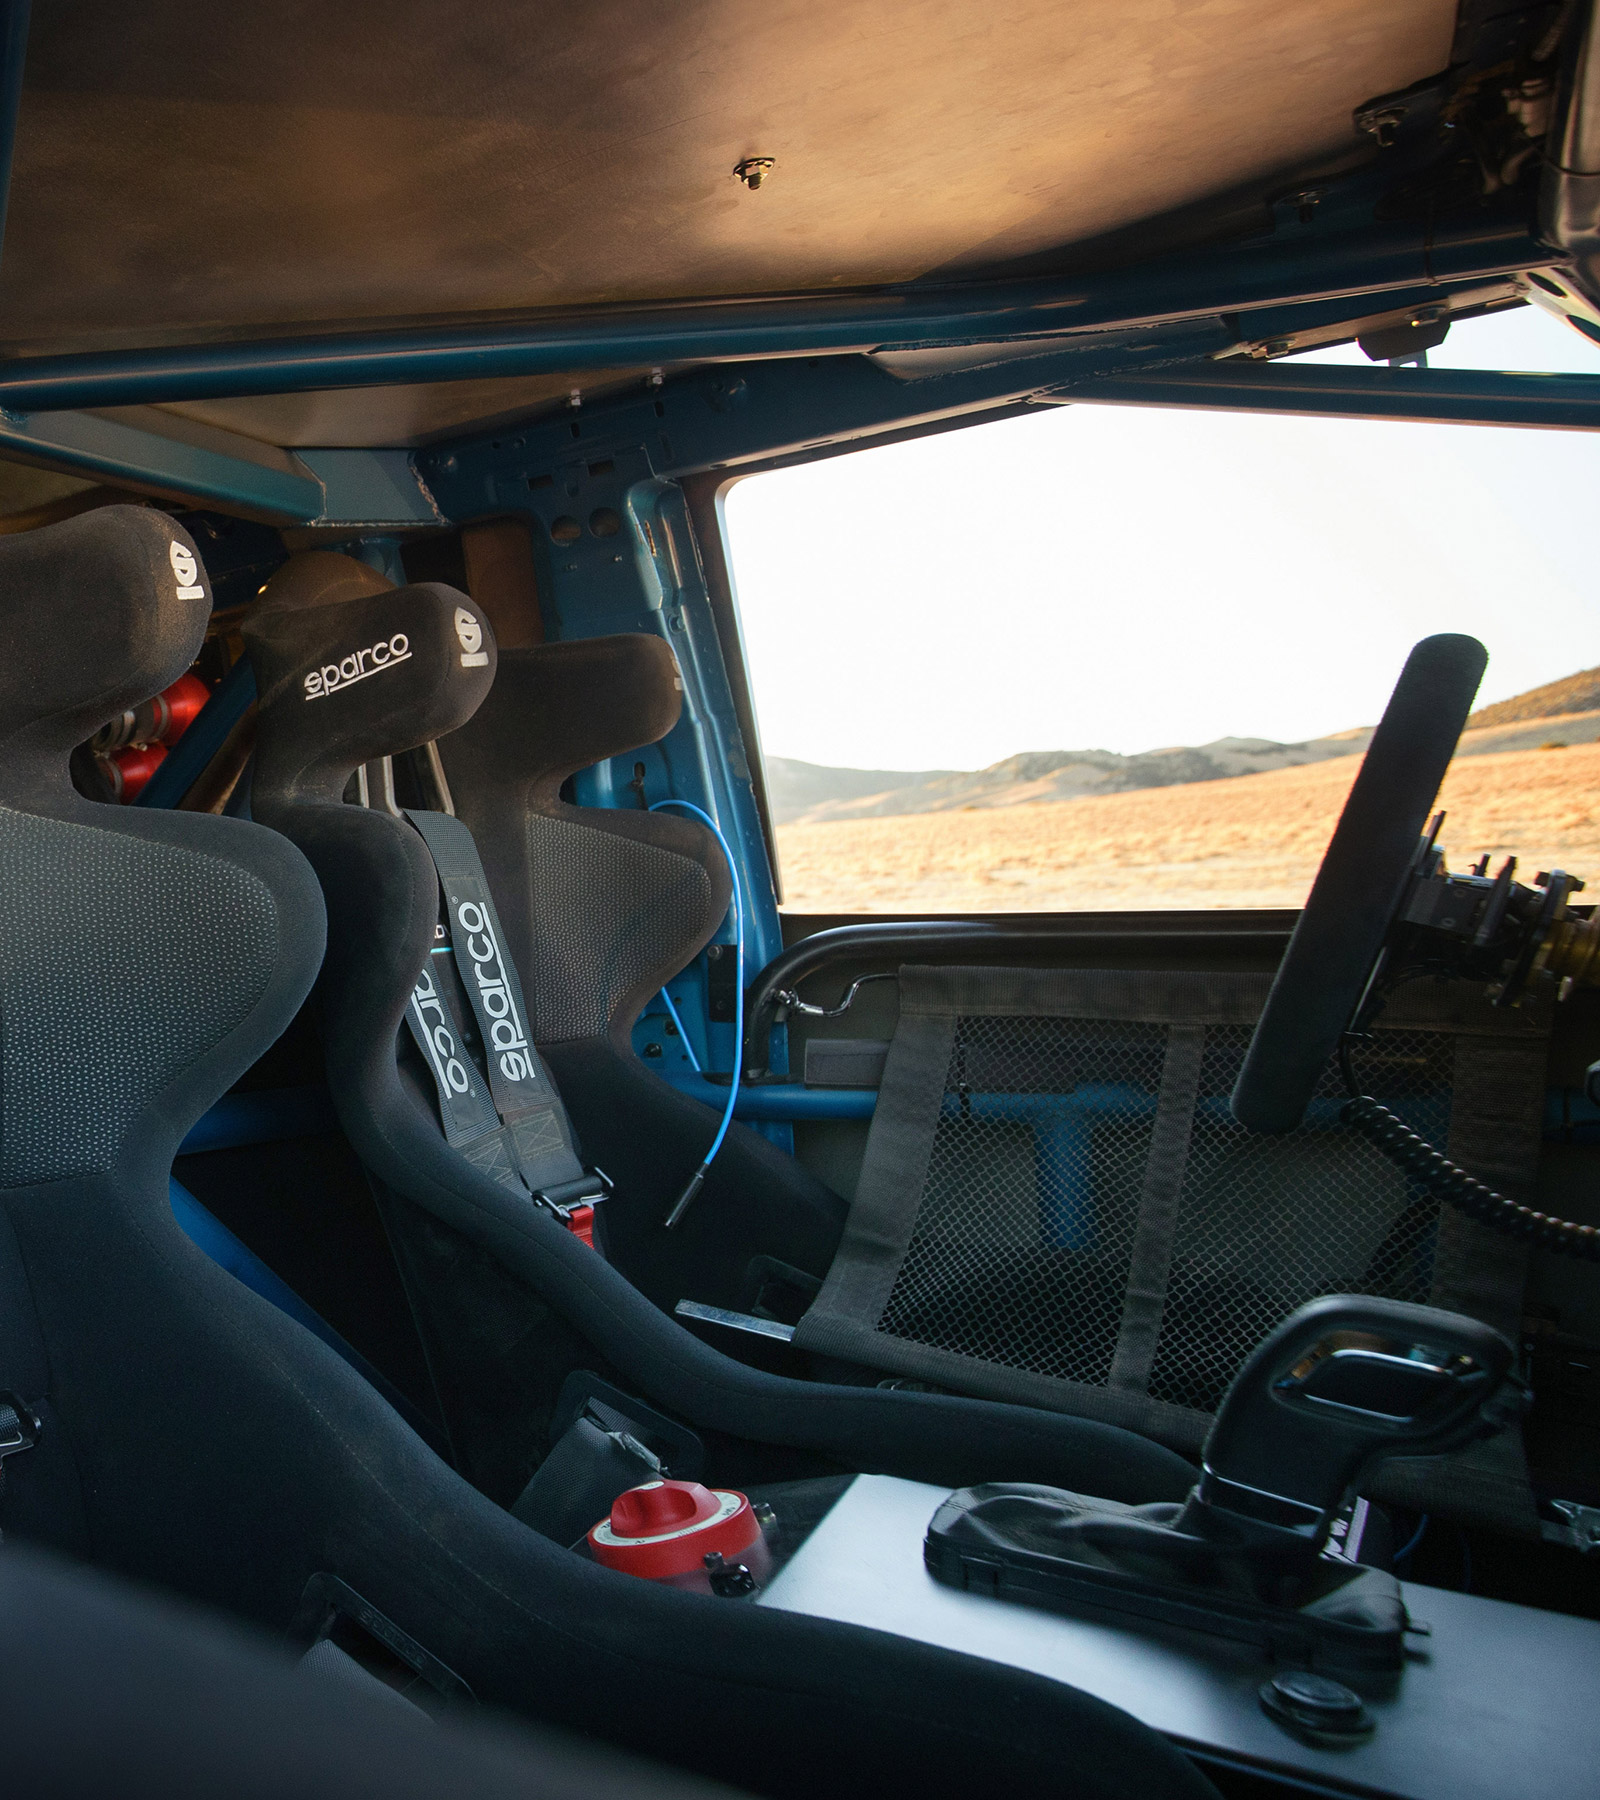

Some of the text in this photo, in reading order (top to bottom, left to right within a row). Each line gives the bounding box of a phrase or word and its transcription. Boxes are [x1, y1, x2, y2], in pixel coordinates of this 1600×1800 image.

[303, 633, 413, 701] sparco
[410, 968, 469, 1099] arco
[457, 902, 536, 1081] sparco
